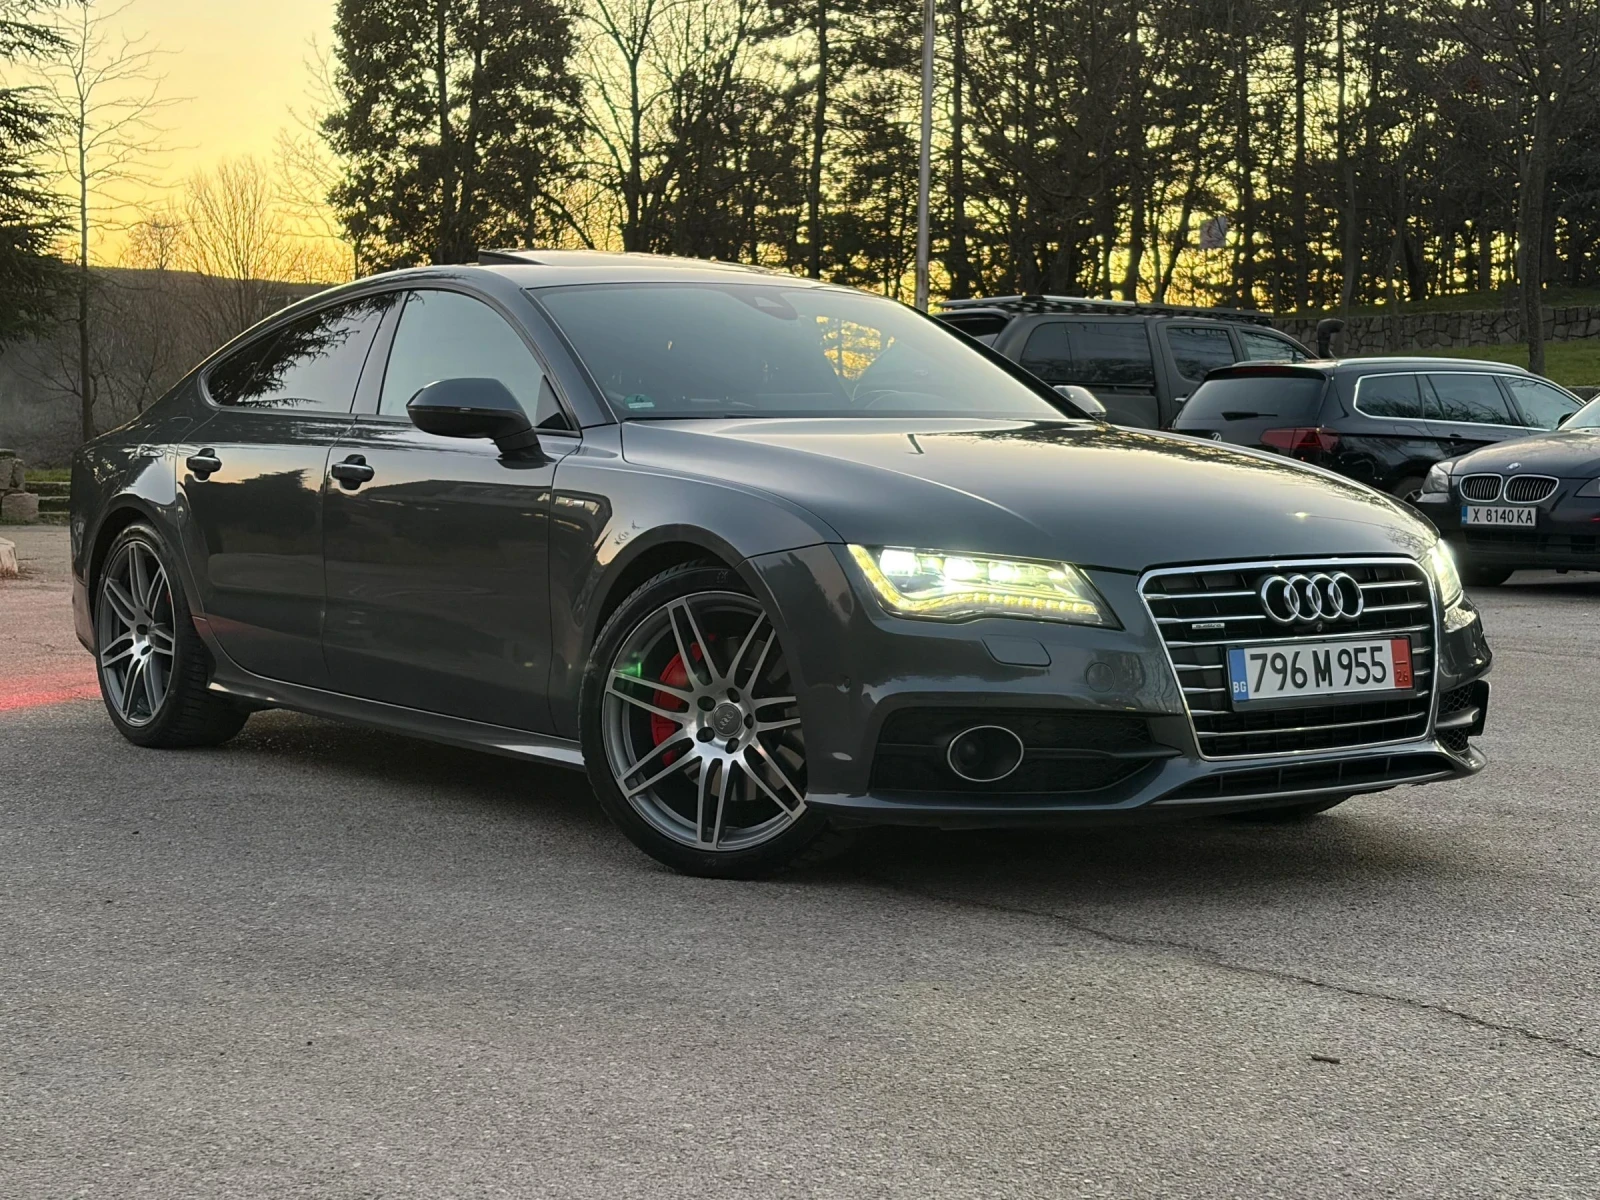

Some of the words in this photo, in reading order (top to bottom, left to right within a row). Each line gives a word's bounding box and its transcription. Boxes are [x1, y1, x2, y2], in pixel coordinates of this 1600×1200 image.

[1472, 508, 1480, 523] X
[1486, 508, 1514, 523] 8140
[1249, 651, 1308, 694] 796
[1312, 649, 1333, 688] M
[1337, 645, 1387, 686] 955
[1396, 669, 1409, 683] 26
[1233, 681, 1247, 693] BG
